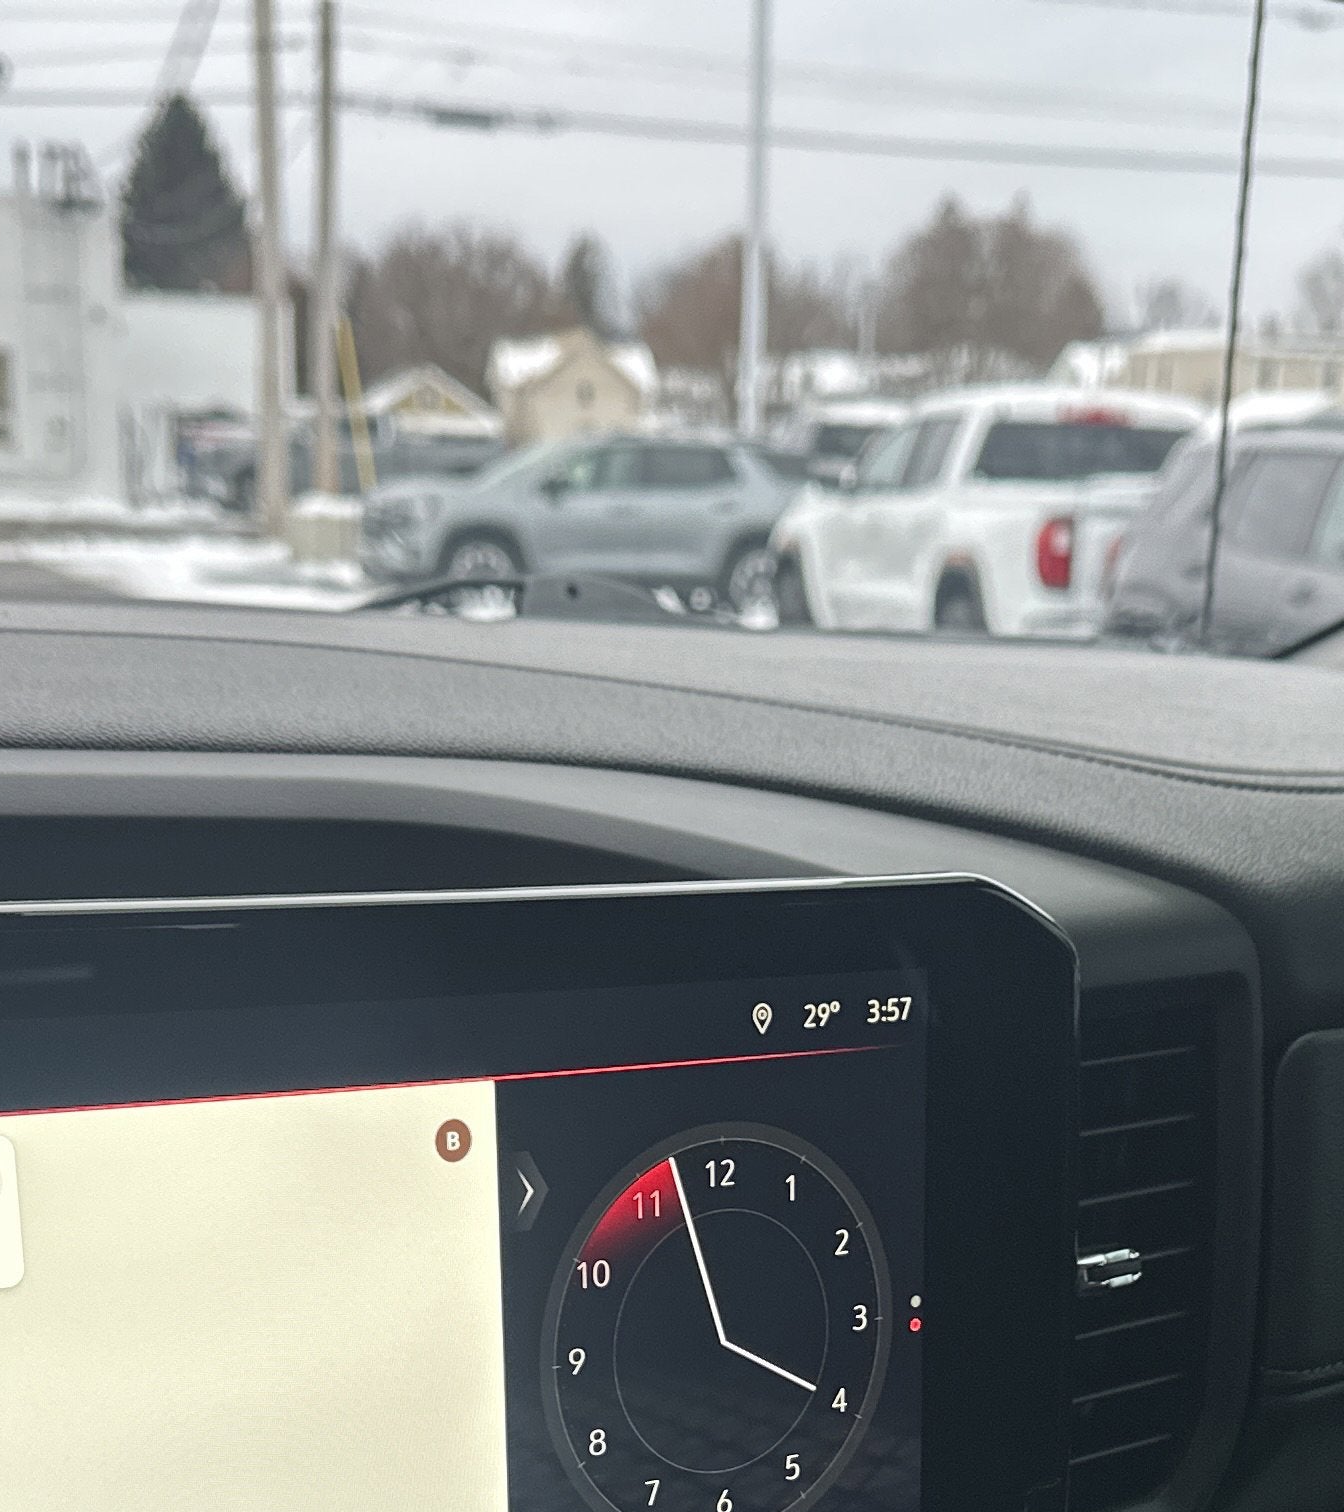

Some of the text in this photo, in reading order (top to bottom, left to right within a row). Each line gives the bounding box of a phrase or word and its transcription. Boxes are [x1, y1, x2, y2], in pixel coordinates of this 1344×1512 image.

[866, 996, 912, 1023] 3:57
[445, 1131, 461, 1150] B
[705, 1159, 736, 1187] 12
[785, 1175, 797, 1201] 1
[632, 1190, 662, 1219] 11
[835, 1230, 850, 1255] 2
[576, 1260, 611, 1288] 10
[853, 1305, 868, 1331] 3
[568, 1348, 586, 1375] 9
[831, 1388, 848, 1413] 4
[588, 1429, 607, 1456] 8
[785, 1455, 801, 1481] 5
[644, 1480, 660, 1506] 7
